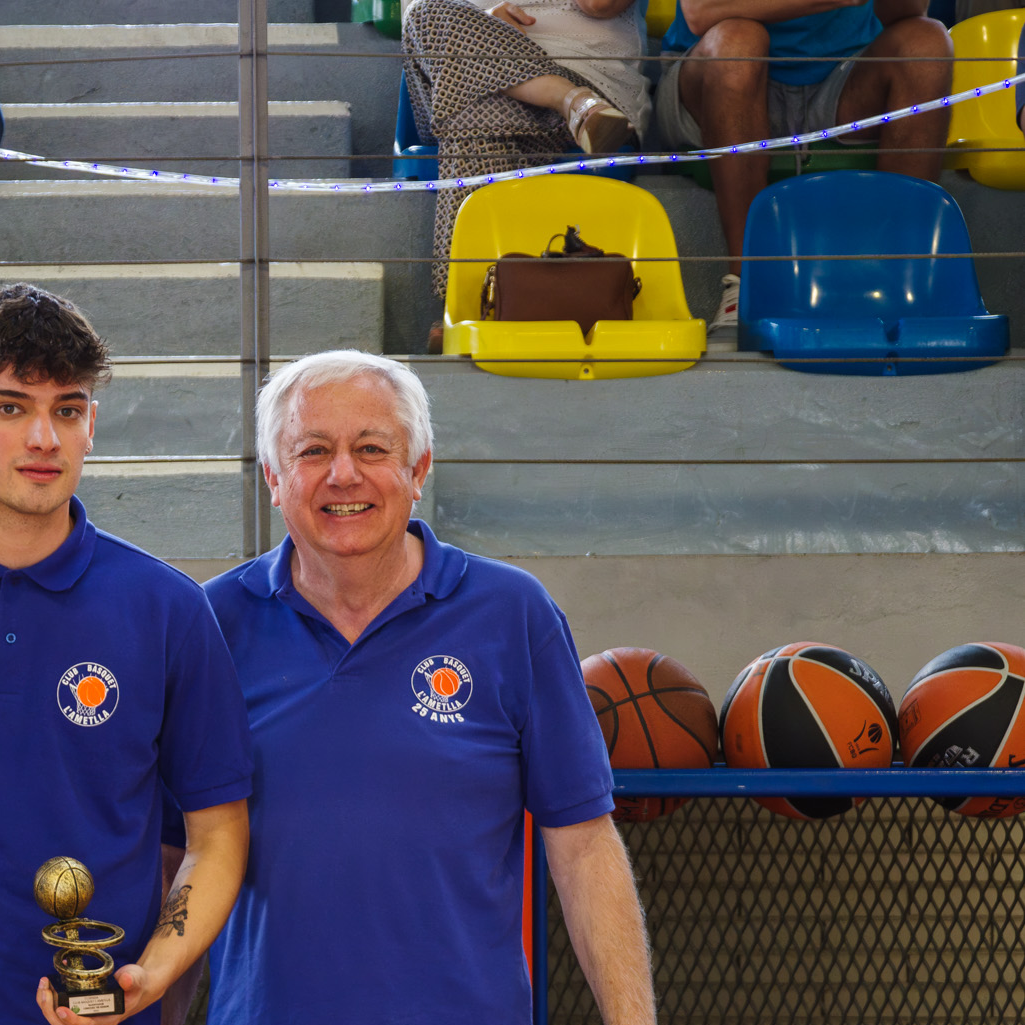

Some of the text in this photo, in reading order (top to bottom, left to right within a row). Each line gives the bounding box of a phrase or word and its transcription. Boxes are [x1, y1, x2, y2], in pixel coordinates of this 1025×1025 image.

[61, 664, 117, 689] CLUB BASQUET
[417, 657, 471, 683] CLUB BASQUET
[416, 690, 463, 711] L'AMETLLA
[63, 705, 110, 725] L'AMETLLA
[411, 702, 465, 723] 25 ANYS
